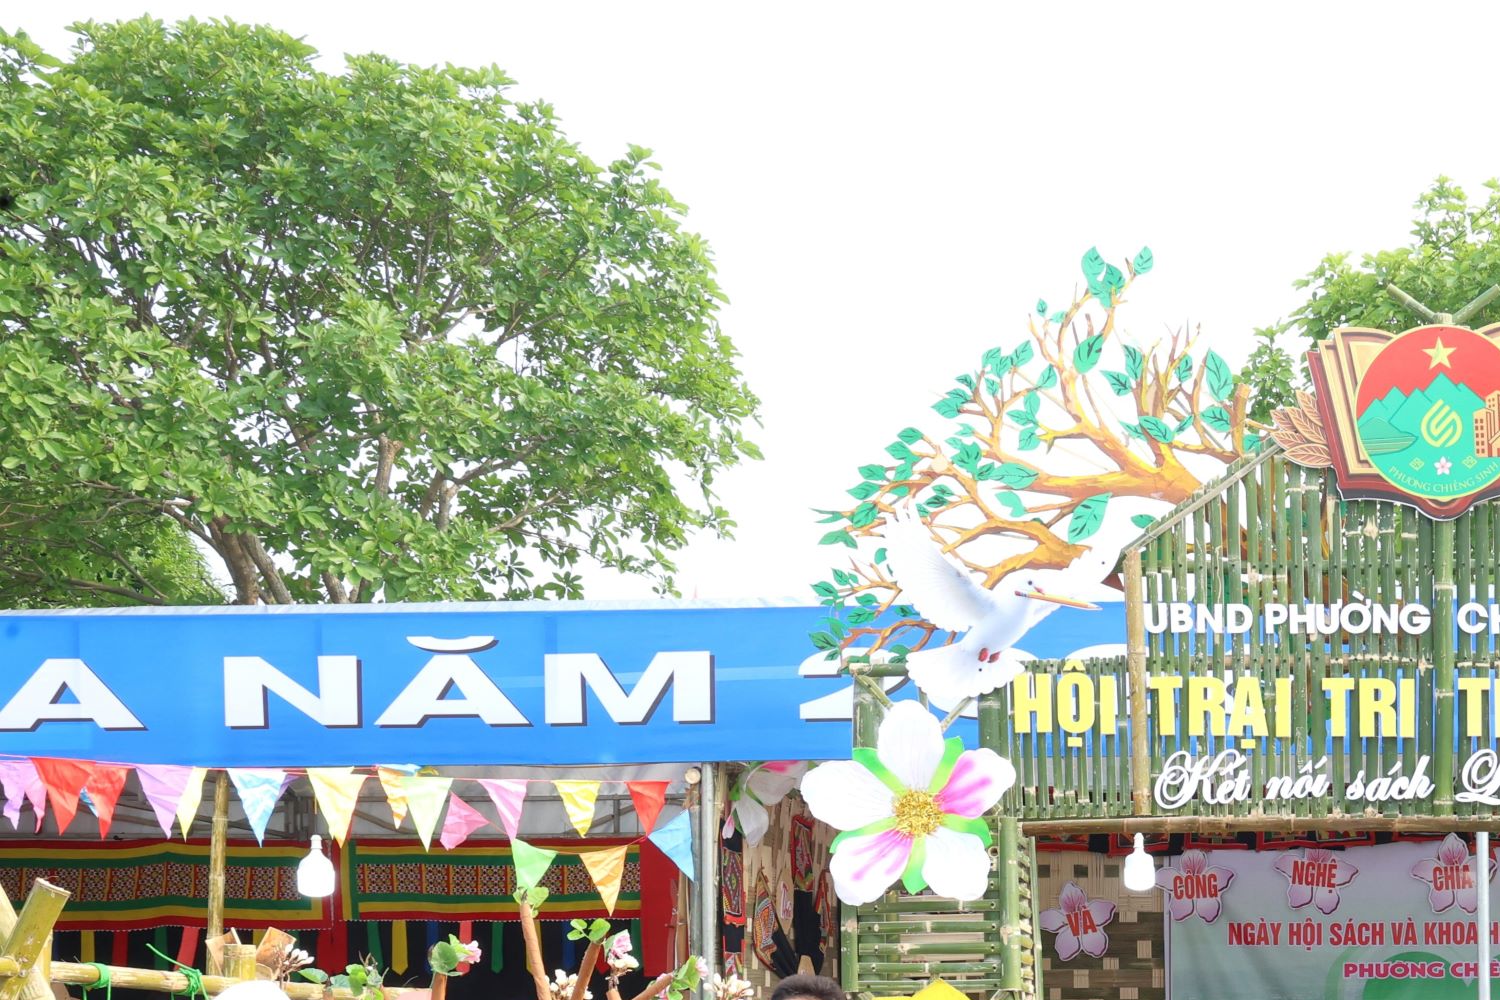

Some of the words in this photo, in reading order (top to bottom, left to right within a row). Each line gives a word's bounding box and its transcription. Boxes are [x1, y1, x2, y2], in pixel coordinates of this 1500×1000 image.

[1144, 602, 1253, 634] UBND
[1265, 591, 1431, 635] PHƯỜNG
[223, 636, 716, 727] NĂM
[1014, 659, 1117, 748] HỘI
[1150, 676, 1292, 749] TRẠI
[1322, 677, 1415, 738] TRI
[1154, 749, 1251, 810] Kết
[1266, 755, 1331, 800] nối
[1345, 755, 1435, 801] sách
[1066, 905, 1097, 937] VÀ
[1173, 870, 1219, 900] CÔNG
[1292, 859, 1338, 894] NGHỆ
[1433, 860, 1474, 892] CHÌA
[1228, 918, 1282, 946] NGÀY
[1288, 918, 1322, 950] HỘI
[1329, 918, 1384, 946] SÁCH
[1391, 917, 1418, 946] VÀ
[1424, 921, 1478, 946] KHOA
